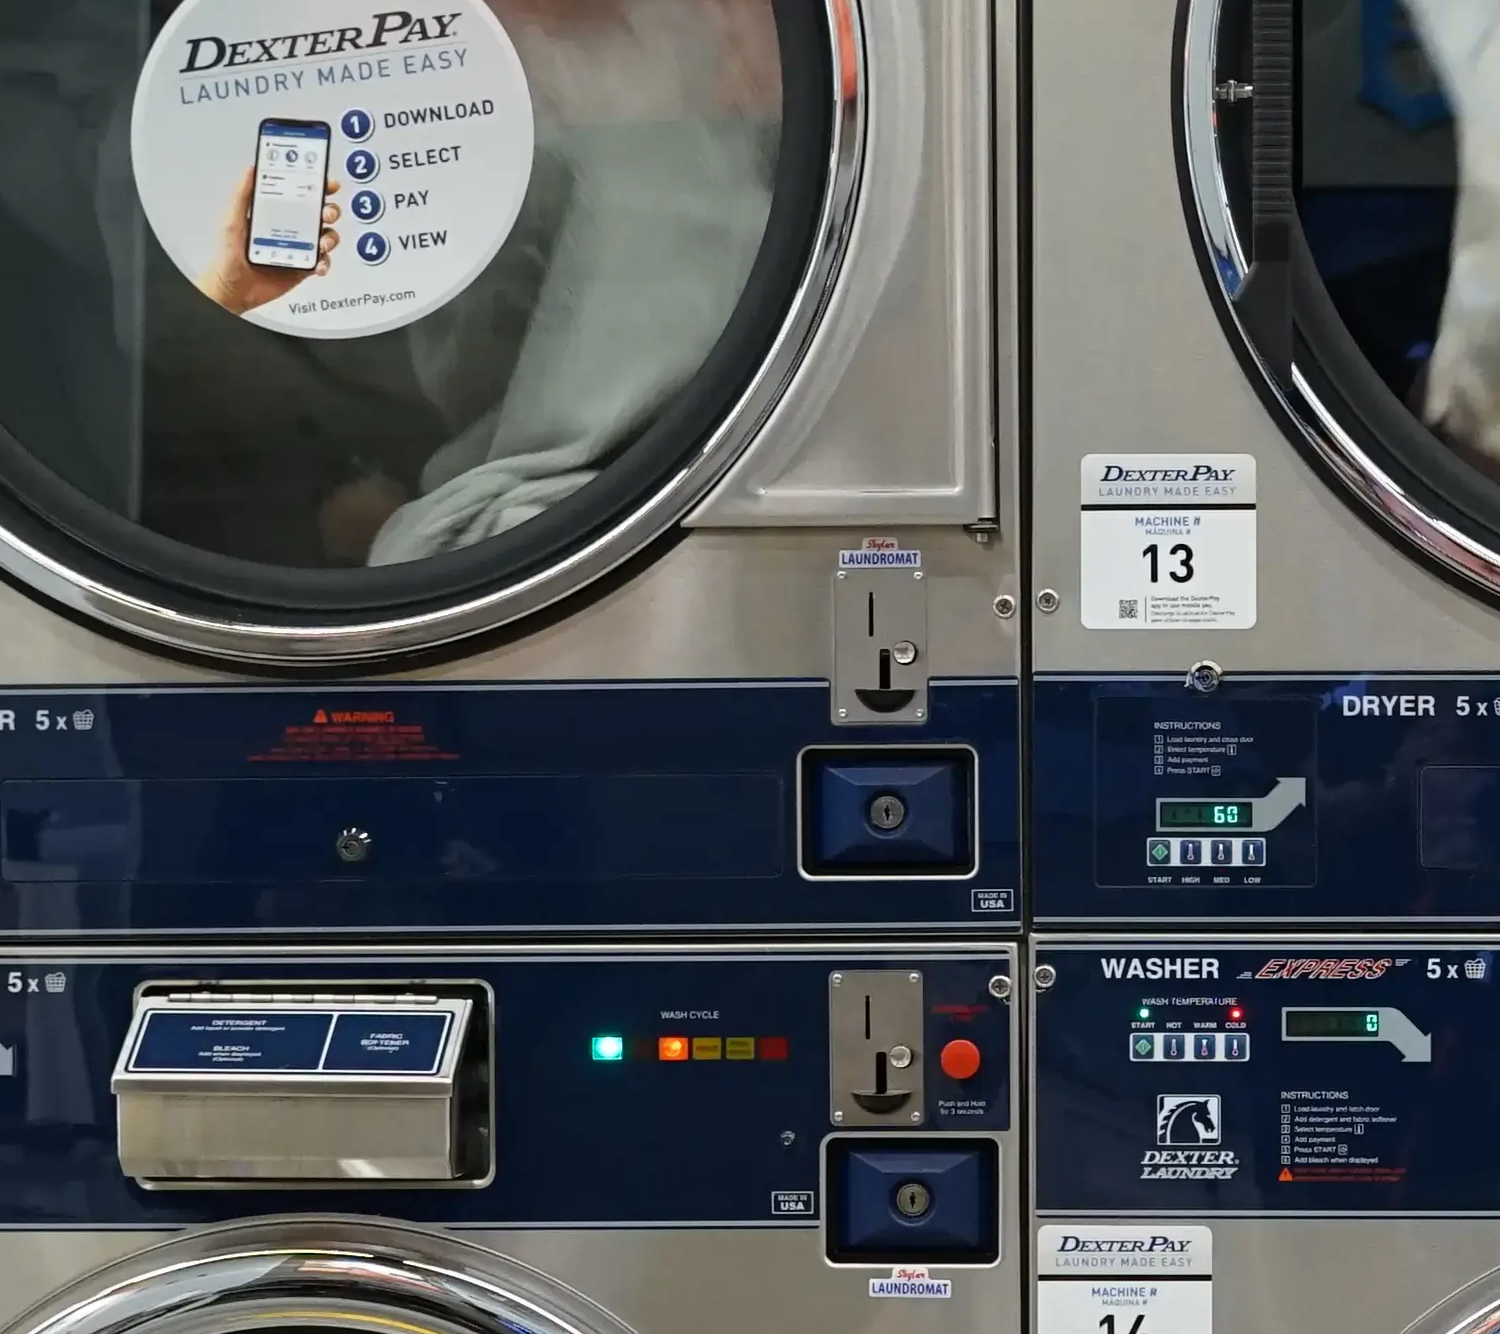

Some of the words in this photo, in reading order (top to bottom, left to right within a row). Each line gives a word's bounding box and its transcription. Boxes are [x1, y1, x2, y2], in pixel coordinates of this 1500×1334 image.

[180, 71, 306, 105] LAUNDRY
[317, 59, 392, 86] MADE
[404, 48, 469, 74] EASY
[349, 116, 360, 134] 1
[384, 100, 495, 128] DOWNLOAD
[354, 157, 367, 174] 2
[389, 146, 462, 170] SELECT
[360, 197, 373, 214] 3
[394, 190, 429, 210] PAY
[364, 238, 378, 256] 4
[398, 231, 448, 251] VIEW
[288, 301, 317, 316] Visit
[320, 289, 416, 312] DexterPay.com
[1135, 517, 1189, 526] MACHINE
[841, 553, 918, 565] LAUNDROMAT
[1143, 544, 1193, 583] 13
[1343, 696, 1435, 716] DRYER
[1101, 958, 1219, 979] WASHER
[780, 1202, 805, 1210] USA
[872, 1281, 949, 1296] LAUNDROMAT
